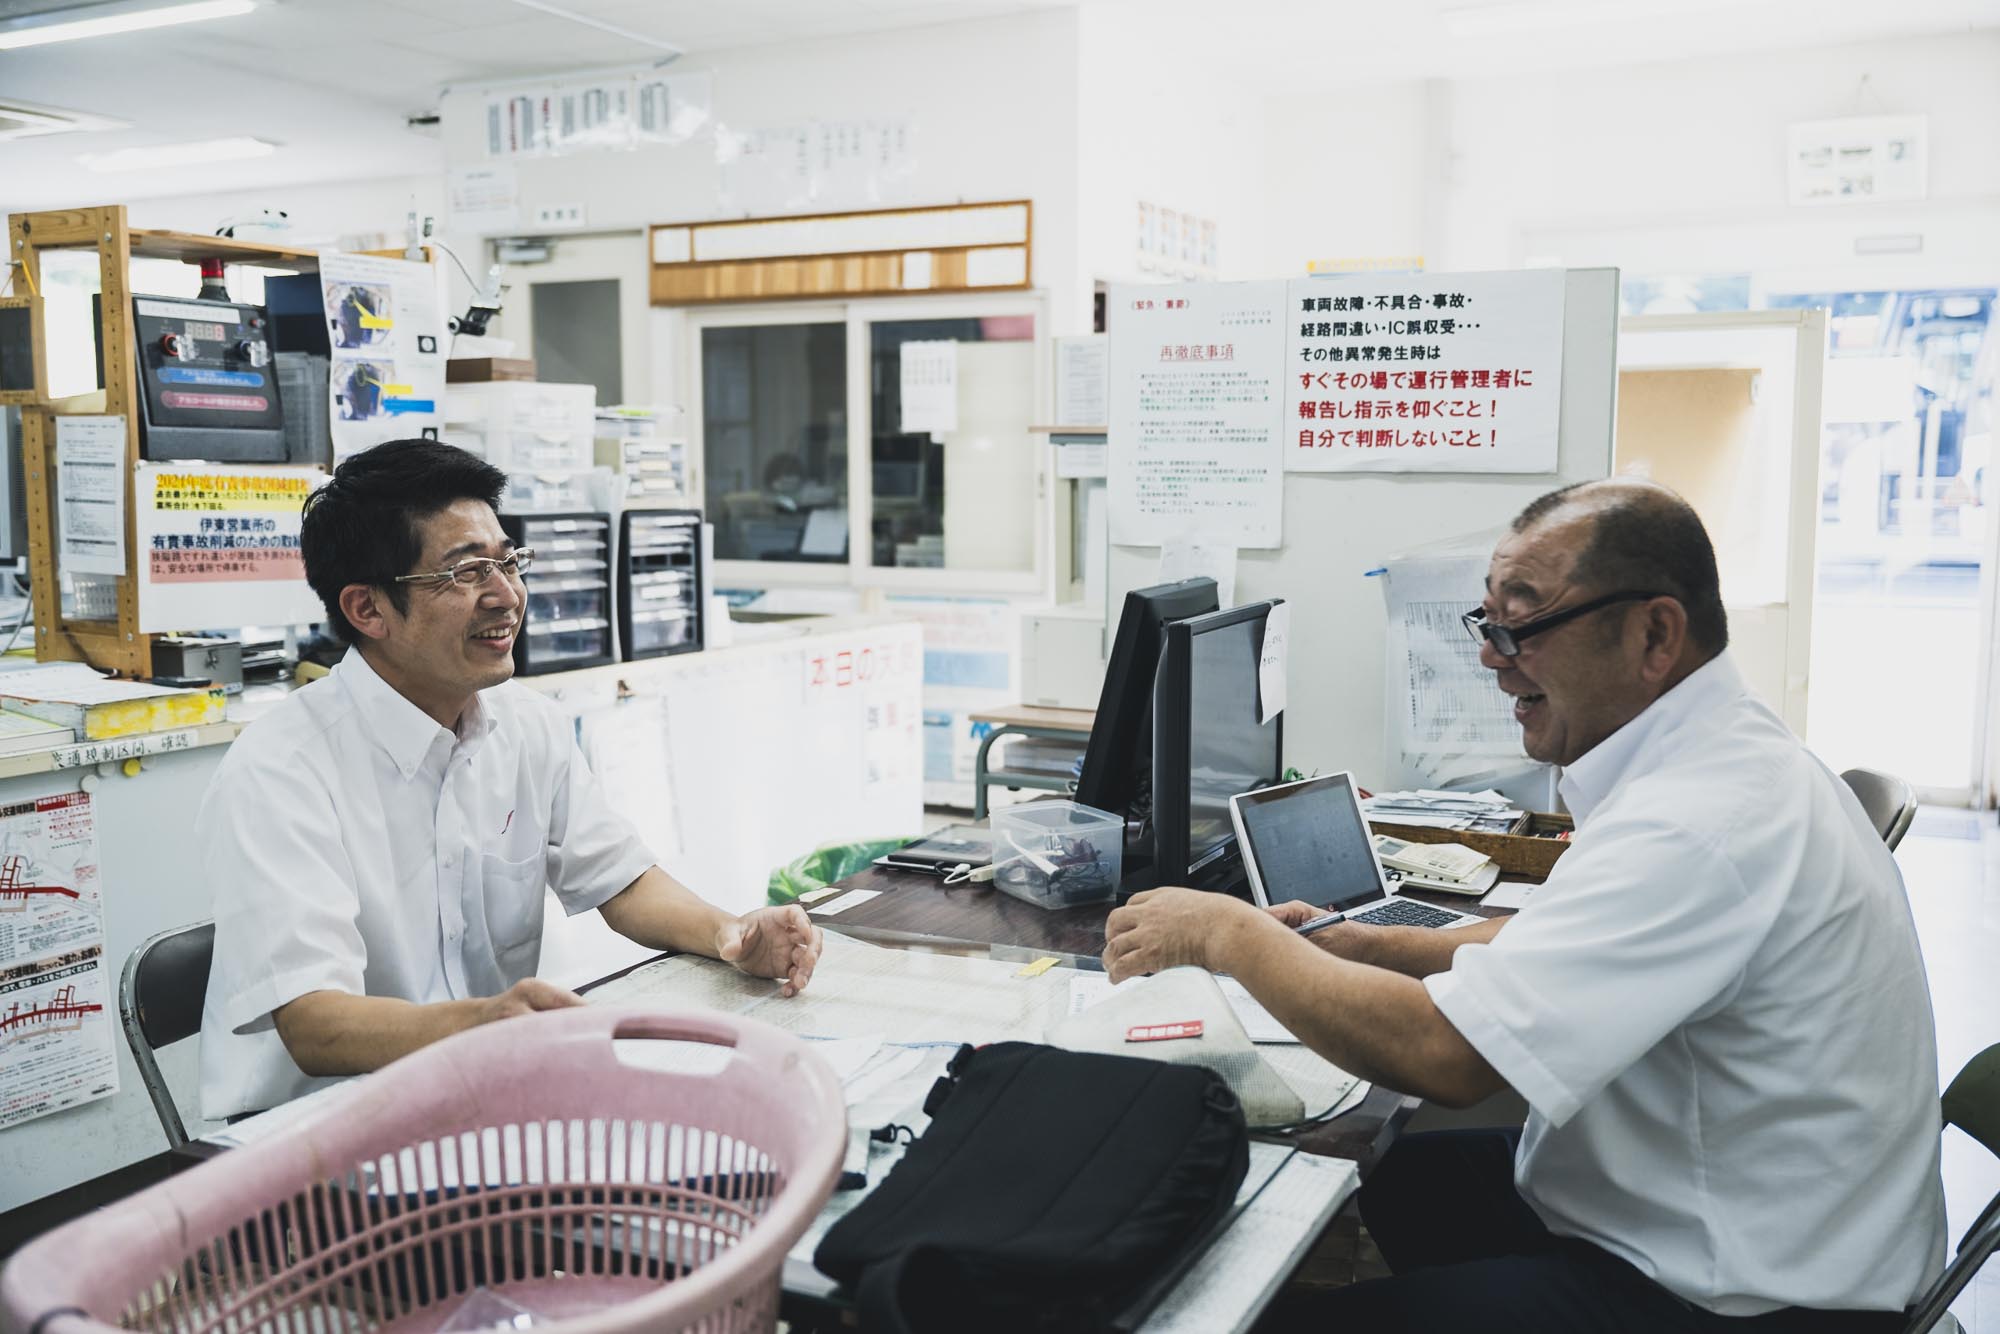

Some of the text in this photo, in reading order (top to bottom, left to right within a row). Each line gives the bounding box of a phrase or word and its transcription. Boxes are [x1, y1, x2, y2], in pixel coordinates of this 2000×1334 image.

[1301, 293, 1472, 312] 車両故障・不具合・事故・
[1300, 318, 1480, 337] 経路間違い・IC誤収受・・・
[1160, 344, 1234, 360] 再徹底事項
[1300, 345, 1441, 361] その他異常発生時は
[1299, 369, 1533, 390] すぐその場で運行管理者に
[1298, 400, 1497, 420] 報告し指示を仰ぐこと！
[1299, 429, 1497, 448] 自分で判断しないこと！
[200, 518, 276, 533] 伊東営業所の
